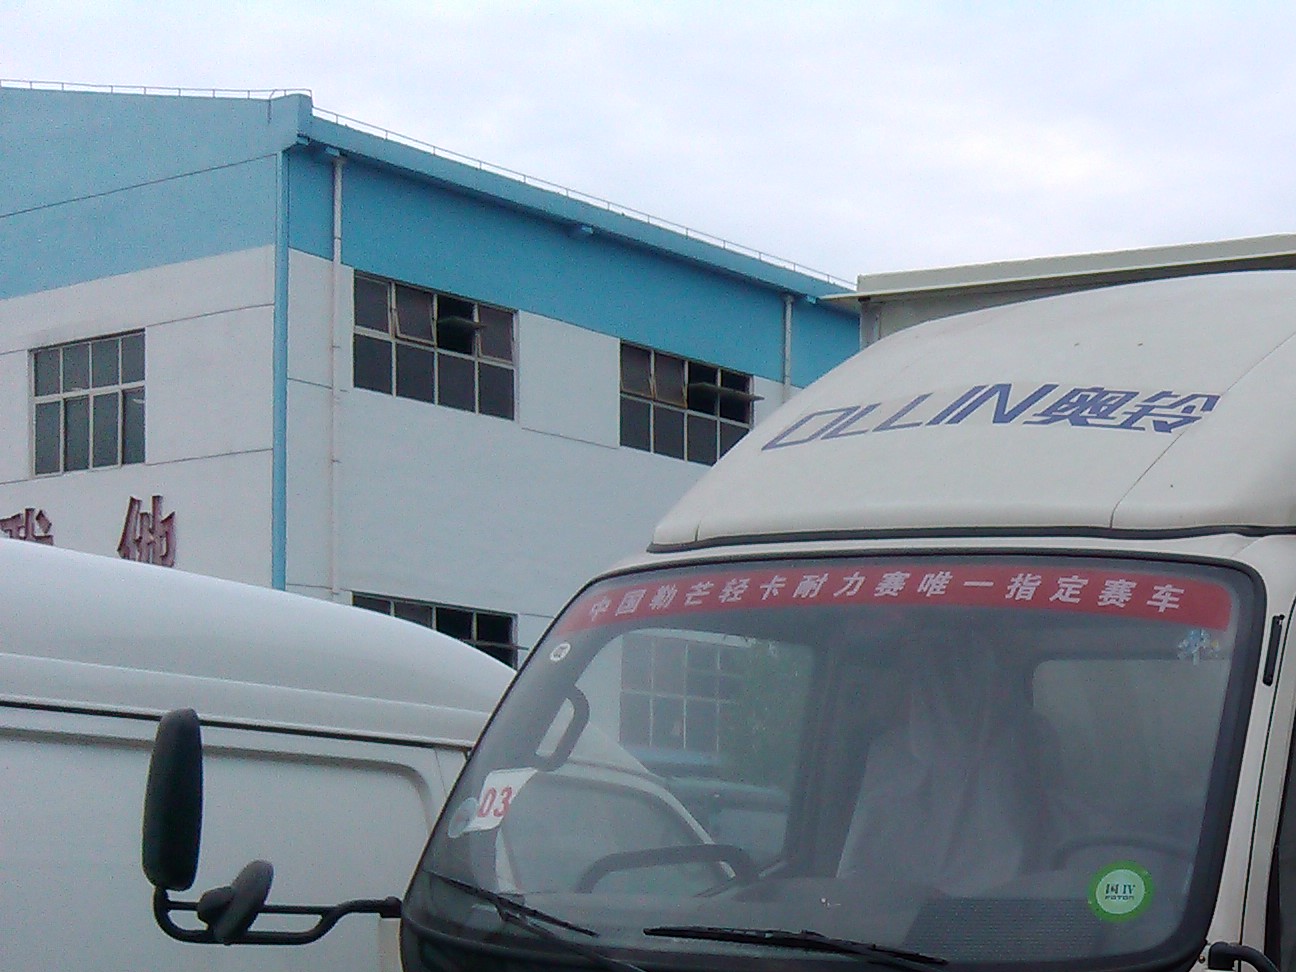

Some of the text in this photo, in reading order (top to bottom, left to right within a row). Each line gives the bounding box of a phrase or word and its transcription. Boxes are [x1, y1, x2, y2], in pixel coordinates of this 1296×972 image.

[590, 571, 1185, 621] 中国勒芒轻卡耐力赛唯一指定赛车
[478, 787, 512, 817] 03
